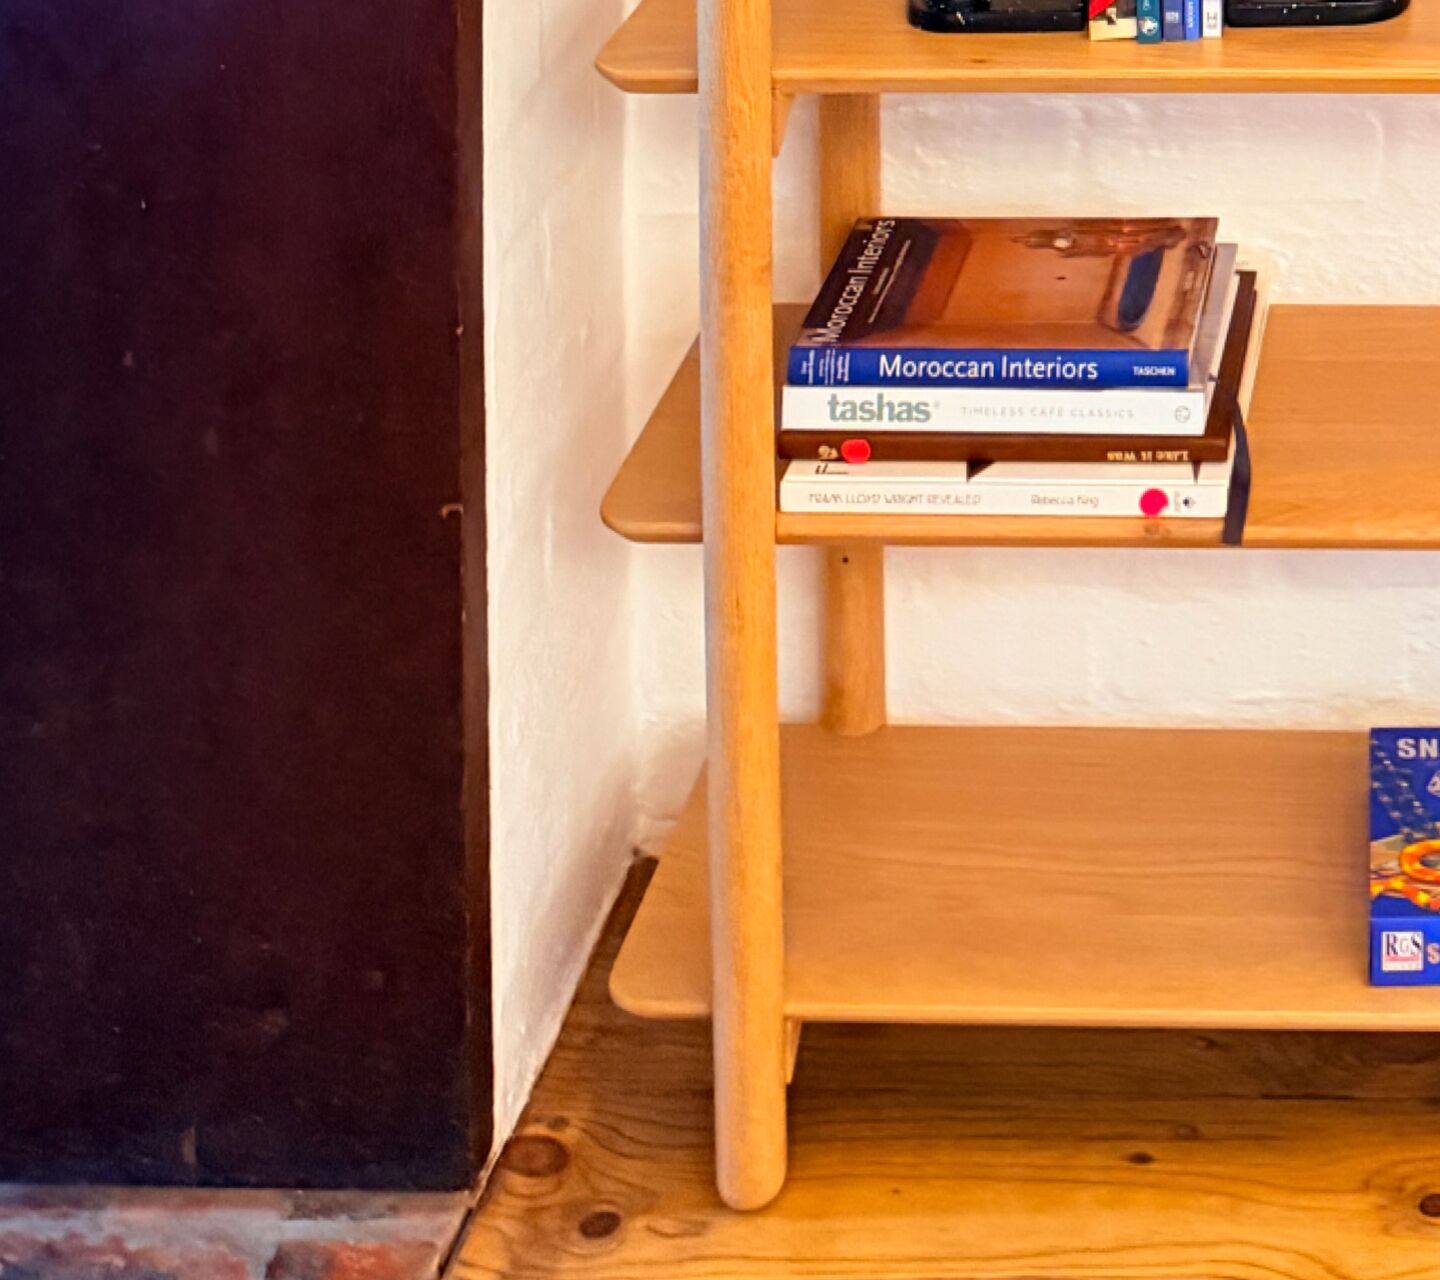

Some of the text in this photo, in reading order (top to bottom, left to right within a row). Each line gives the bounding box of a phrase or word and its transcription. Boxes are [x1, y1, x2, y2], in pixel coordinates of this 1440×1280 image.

[807, 276, 869, 343] Moroccan
[848, 220, 895, 275] Interiors
[879, 354, 994, 379] Moroccan
[1002, 355, 1098, 380] Interiors
[1133, 366, 1176, 376] TASCHEN
[827, 393, 931, 423] tashas
[960, 406, 1025, 418] TIMELESS
[1070, 408, 1135, 419] CLASSICS
[1385, 933, 1422, 956] RGS
